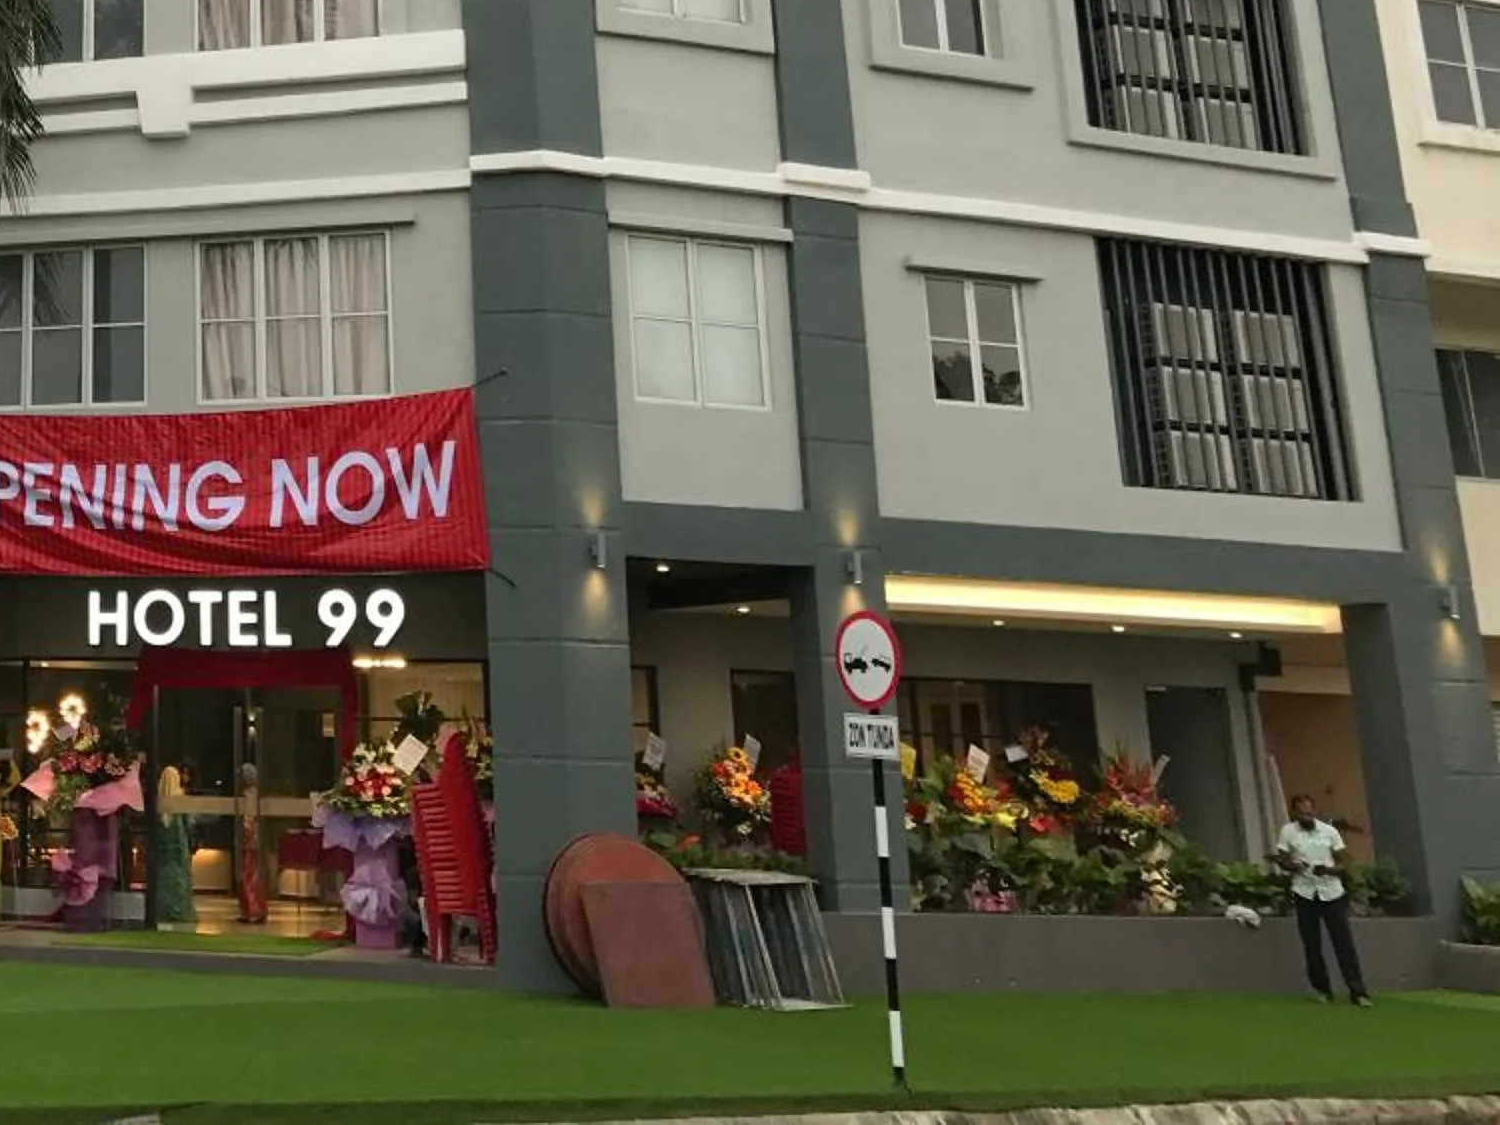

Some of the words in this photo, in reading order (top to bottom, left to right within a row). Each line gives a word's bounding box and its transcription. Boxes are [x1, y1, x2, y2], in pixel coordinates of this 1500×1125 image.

[269, 440, 456, 527] NOW
[88, 590, 292, 647] HOTEL
[317, 589, 406, 647] 99
